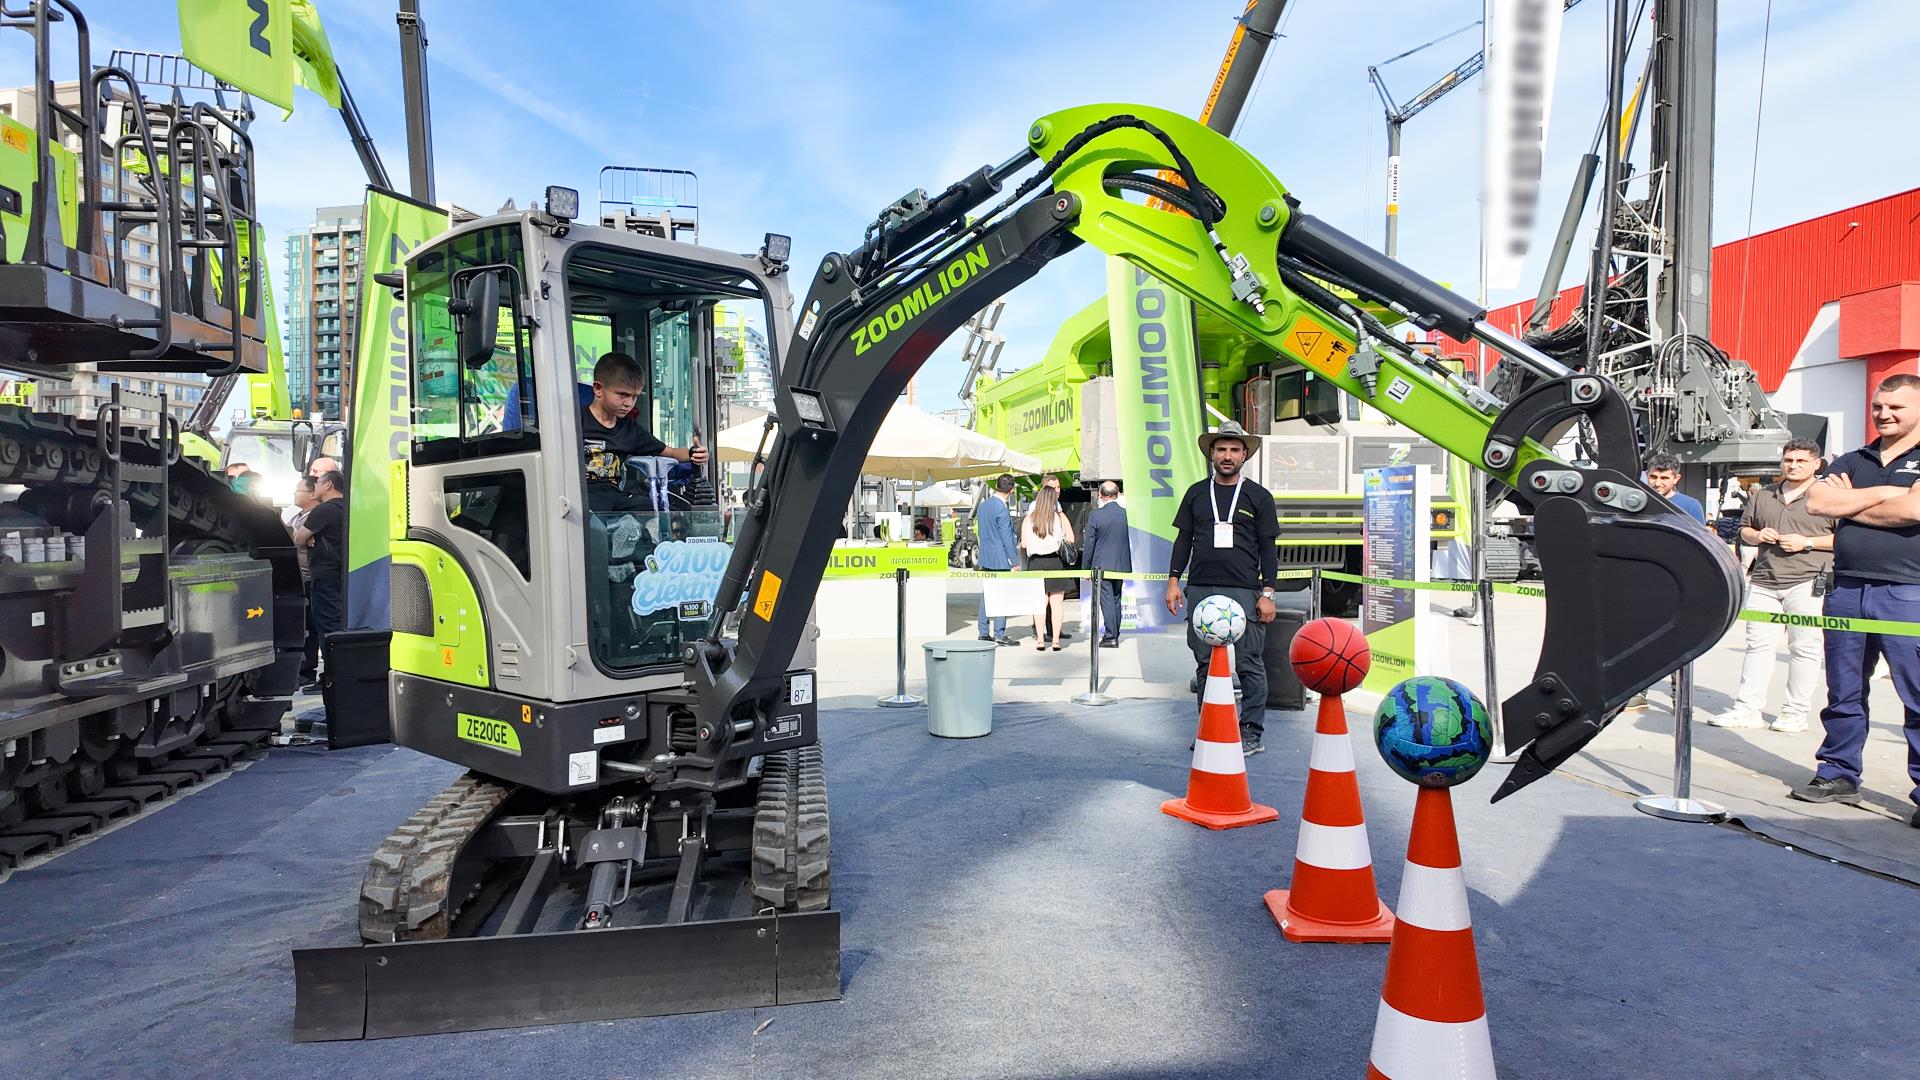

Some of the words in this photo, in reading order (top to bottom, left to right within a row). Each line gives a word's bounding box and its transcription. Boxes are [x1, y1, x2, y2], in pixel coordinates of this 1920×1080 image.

[850, 243, 990, 356] ZOOMLION
[1022, 396, 1073, 433] ZOOMLION
[829, 555, 876, 568] LION
[890, 557, 938, 565] INFORMATION
[950, 571, 997, 579] ZOOMLION
[1361, 576, 1390, 586] ZOOMLION
[639, 575, 719, 607] Elektri
[1516, 585, 1545, 598] ZOOM
[1770, 612, 1850, 629] ZOOMLION
[1372, 653, 1405, 667] ZOOMLION
[794, 689, 805, 703] 87
[466, 718, 508, 745] ZE20GE
